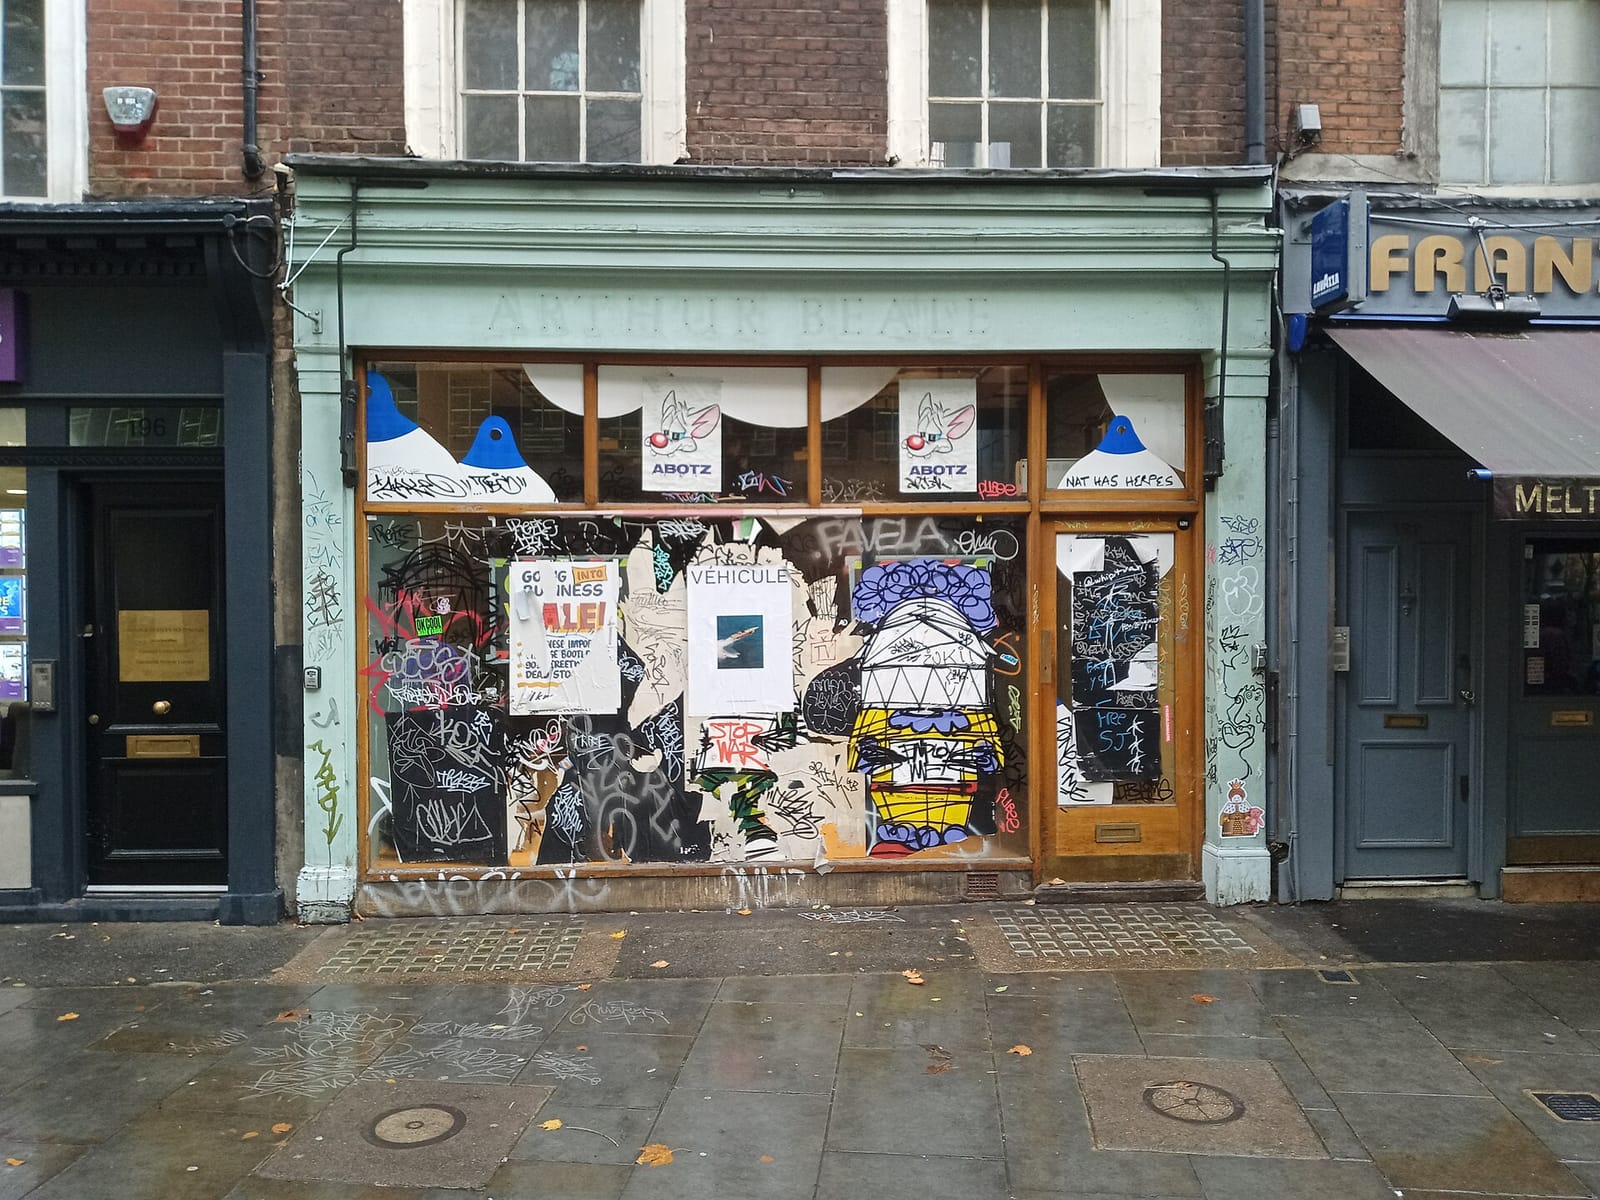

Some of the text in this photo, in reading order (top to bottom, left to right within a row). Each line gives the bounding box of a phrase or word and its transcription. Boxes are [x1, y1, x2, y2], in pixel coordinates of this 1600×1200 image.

[1370, 234, 1600, 294] FRAN
[129, 418, 167, 437] 196
[652, 463, 712, 475] ABOTZ
[909, 465, 968, 476] ABOTZ
[1066, 474, 1174, 487] NAT HAS HERPES
[816, 517, 950, 555] FAVELA
[522, 569, 603, 583] GOG INTO
[691, 566, 788, 585] VÉHICULE
[709, 722, 763, 743] STOP
[717, 739, 769, 772] WAR
